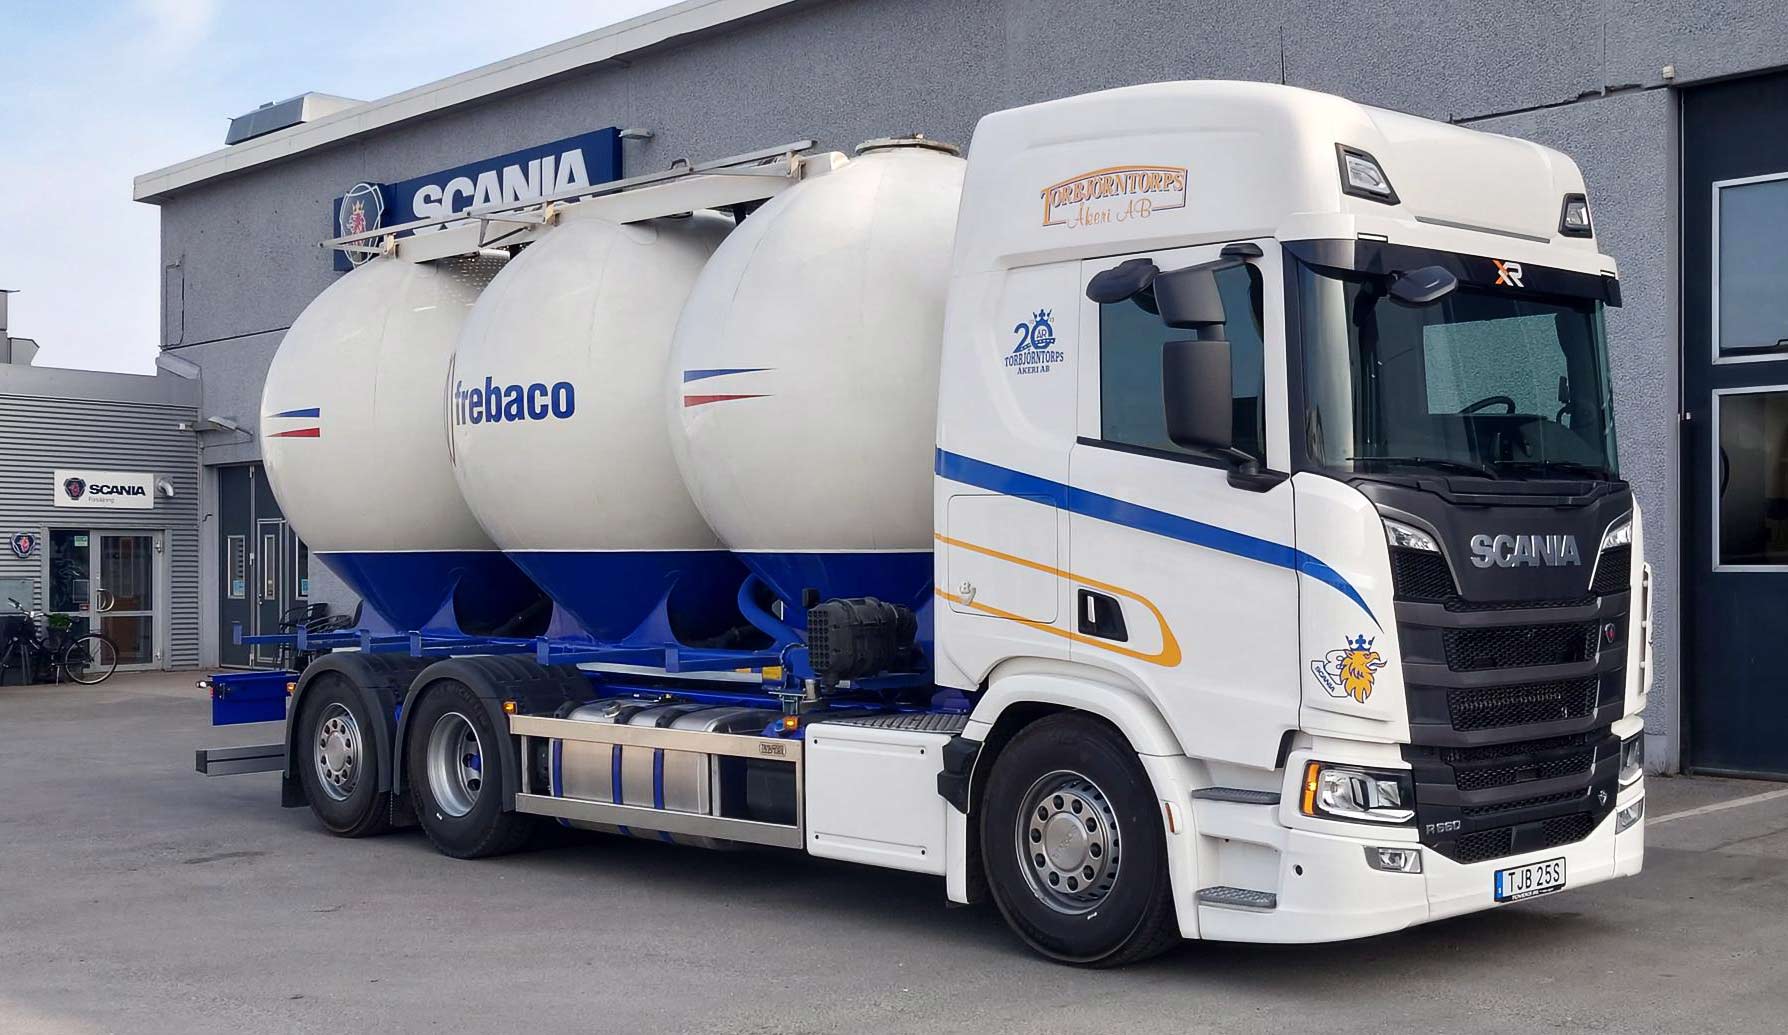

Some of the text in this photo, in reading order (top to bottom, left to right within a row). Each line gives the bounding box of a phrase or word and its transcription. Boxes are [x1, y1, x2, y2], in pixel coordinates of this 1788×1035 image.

[412, 148, 592, 234] SCANIA
[1116, 198, 1152, 222] AB
[454, 376, 575, 426] frebaco
[89, 484, 146, 496] SCANIA
[1470, 534, 1582, 568] SCANIA
[1425, 823, 1435, 835] R
[1508, 863, 1560, 893] TJB 25S
